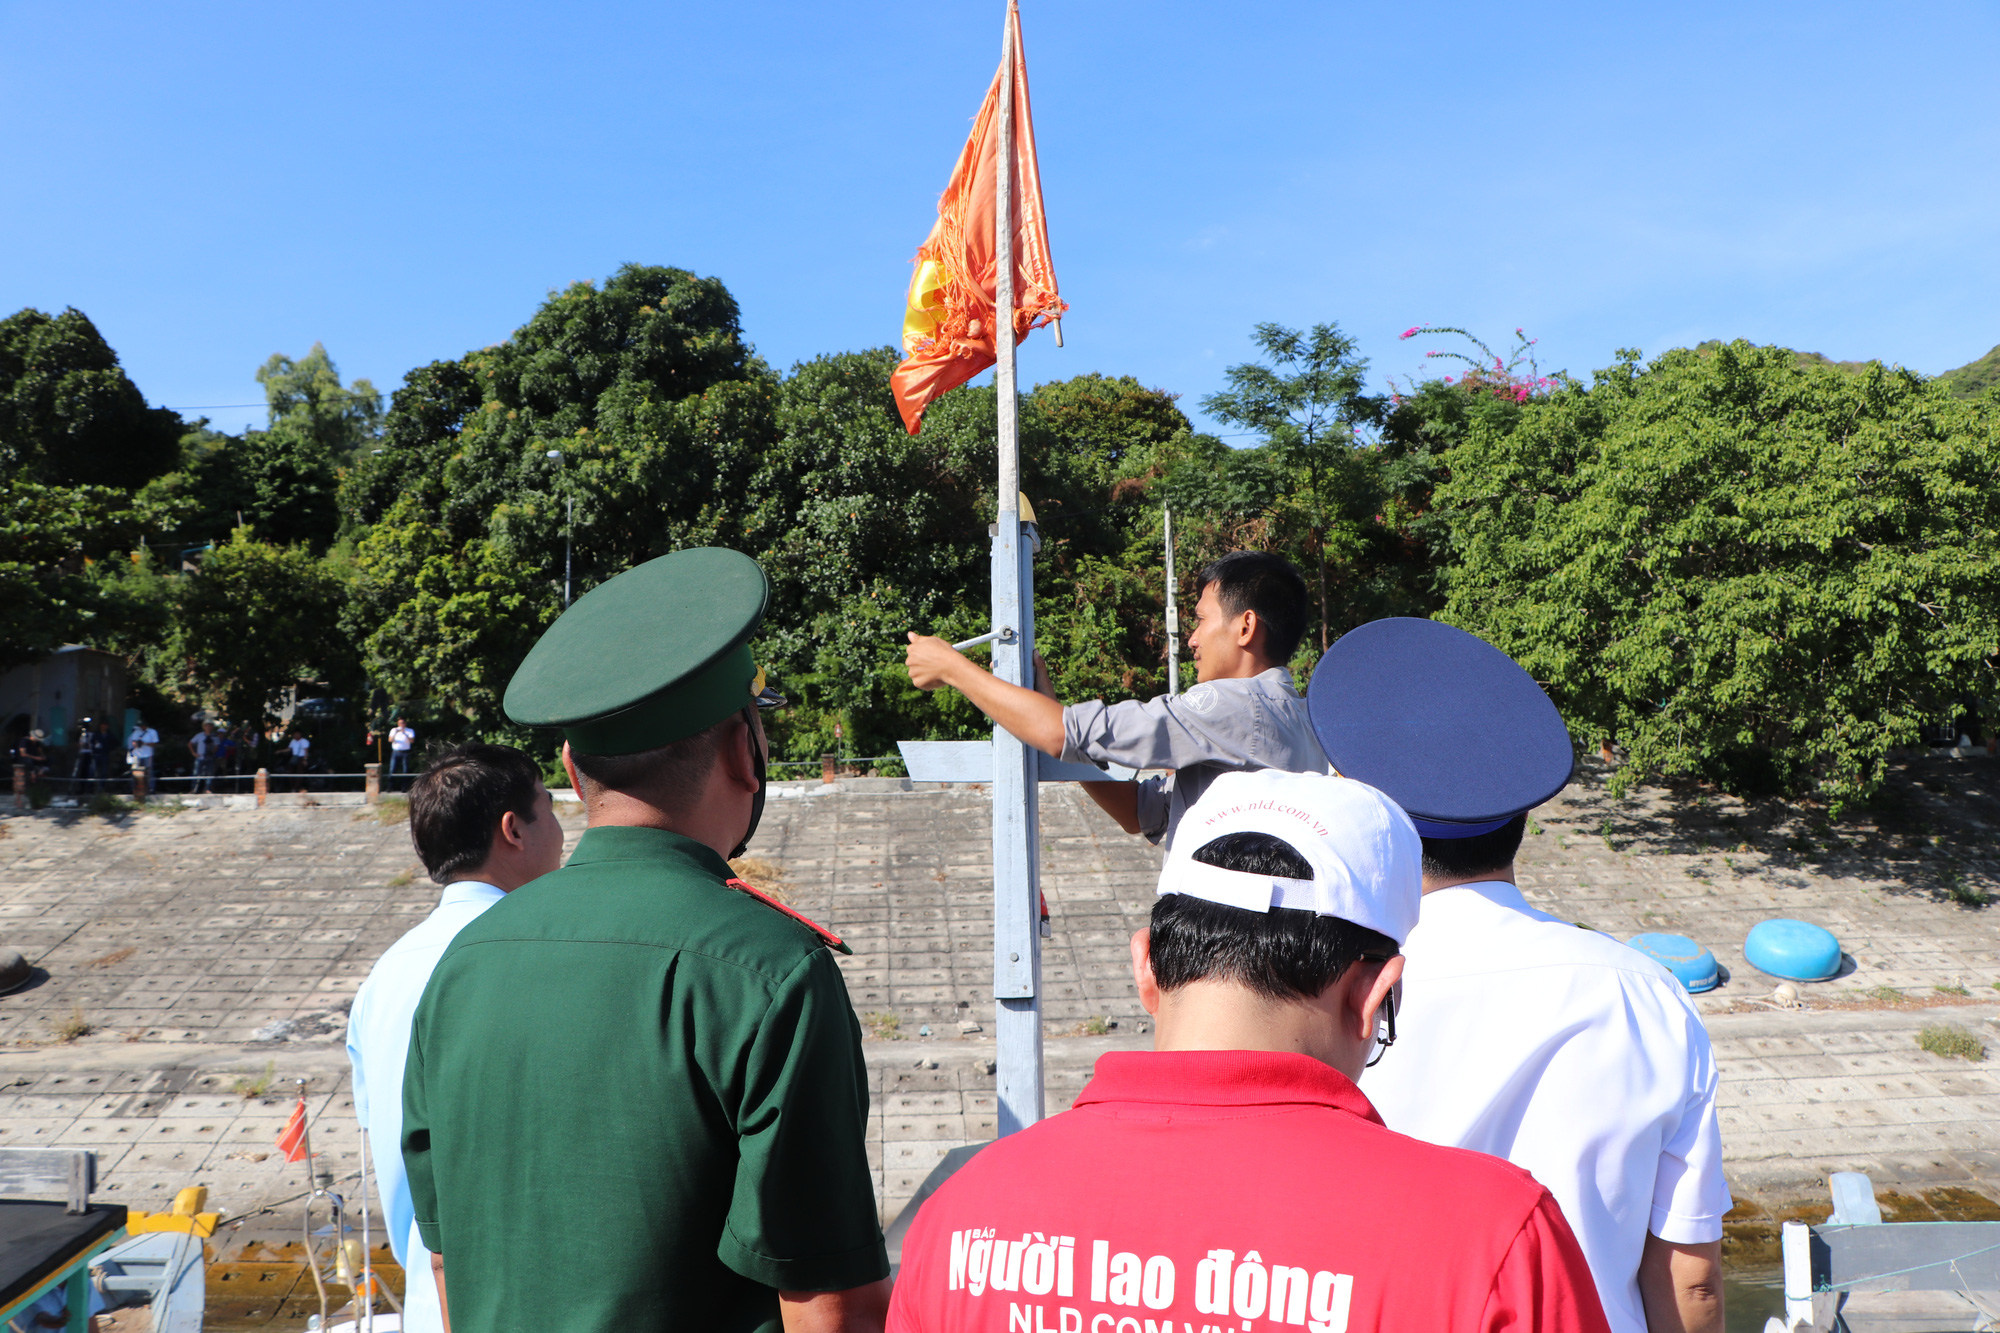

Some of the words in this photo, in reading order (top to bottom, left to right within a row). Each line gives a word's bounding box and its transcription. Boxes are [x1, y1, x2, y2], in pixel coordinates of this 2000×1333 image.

[1205, 800, 1329, 837] www.nld.com.vn
[972, 1226, 996, 1239] BÁO
[949, 1229, 1076, 1297] Người
[1090, 1239, 1176, 1310] lao
[1195, 1249, 1354, 1333] động
